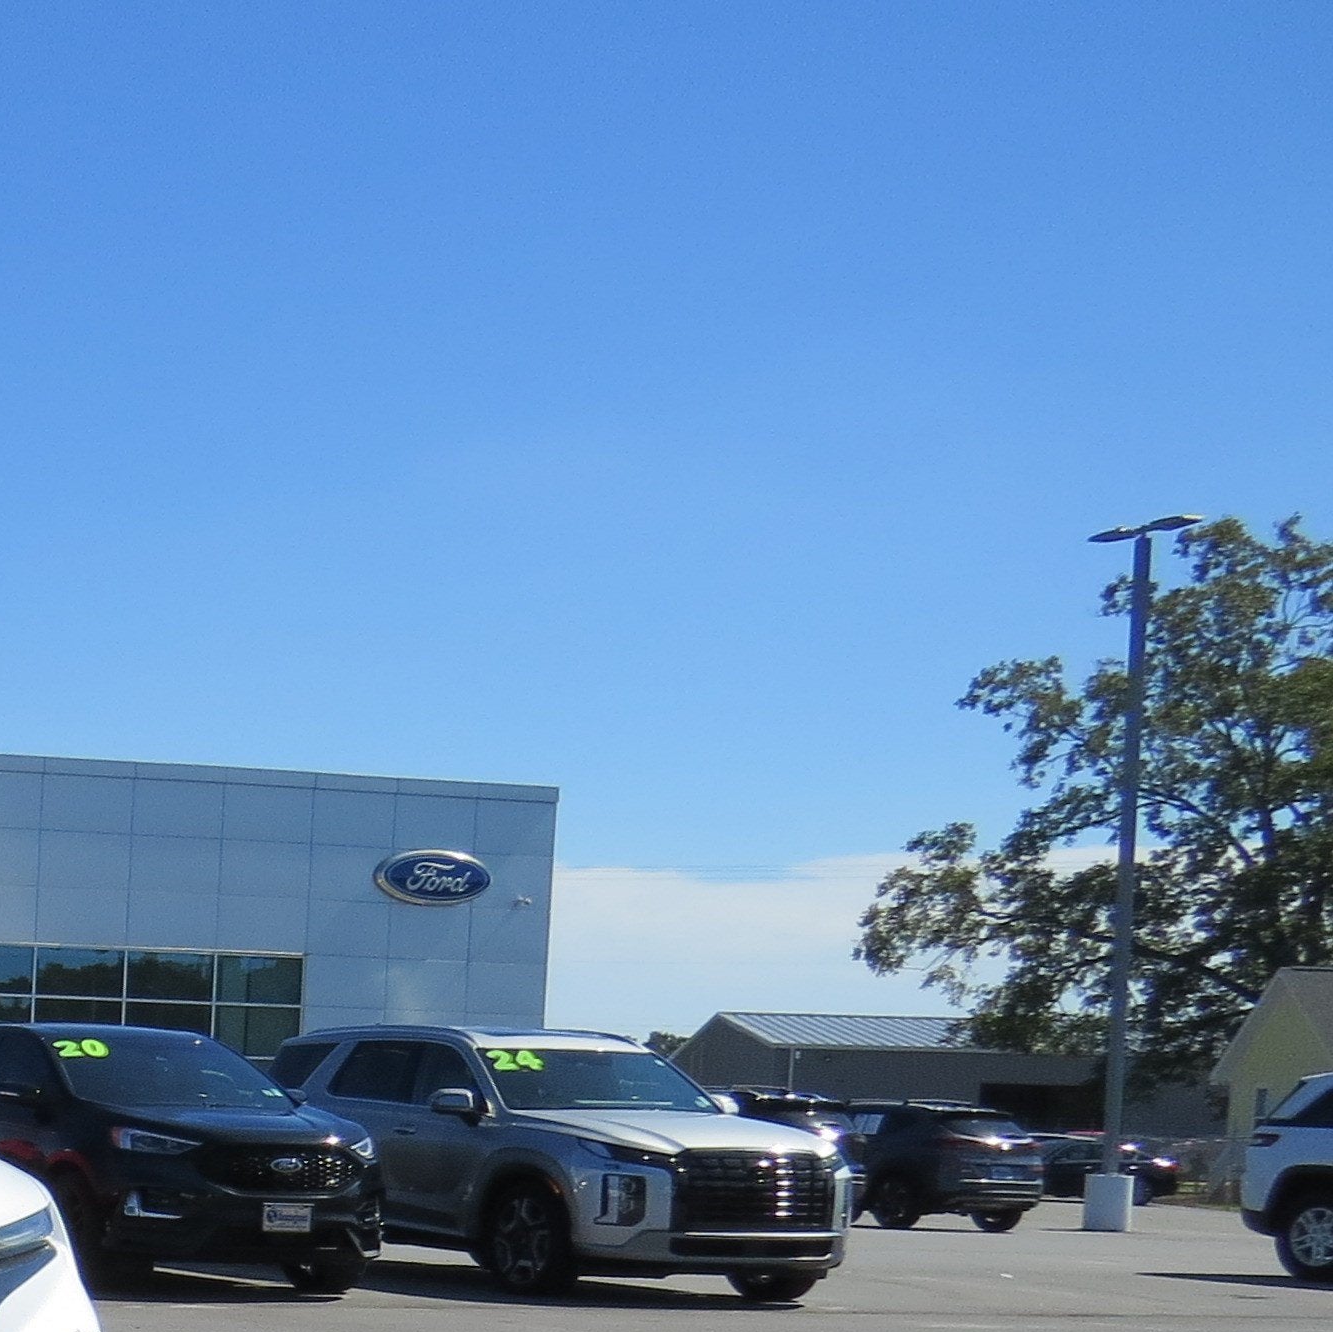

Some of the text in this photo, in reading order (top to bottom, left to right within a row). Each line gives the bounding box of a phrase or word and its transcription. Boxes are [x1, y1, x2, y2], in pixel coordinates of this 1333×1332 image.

[405, 860, 472, 893] Ford
[51, 1038, 110, 1058] 20
[485, 1049, 545, 1072] 24
